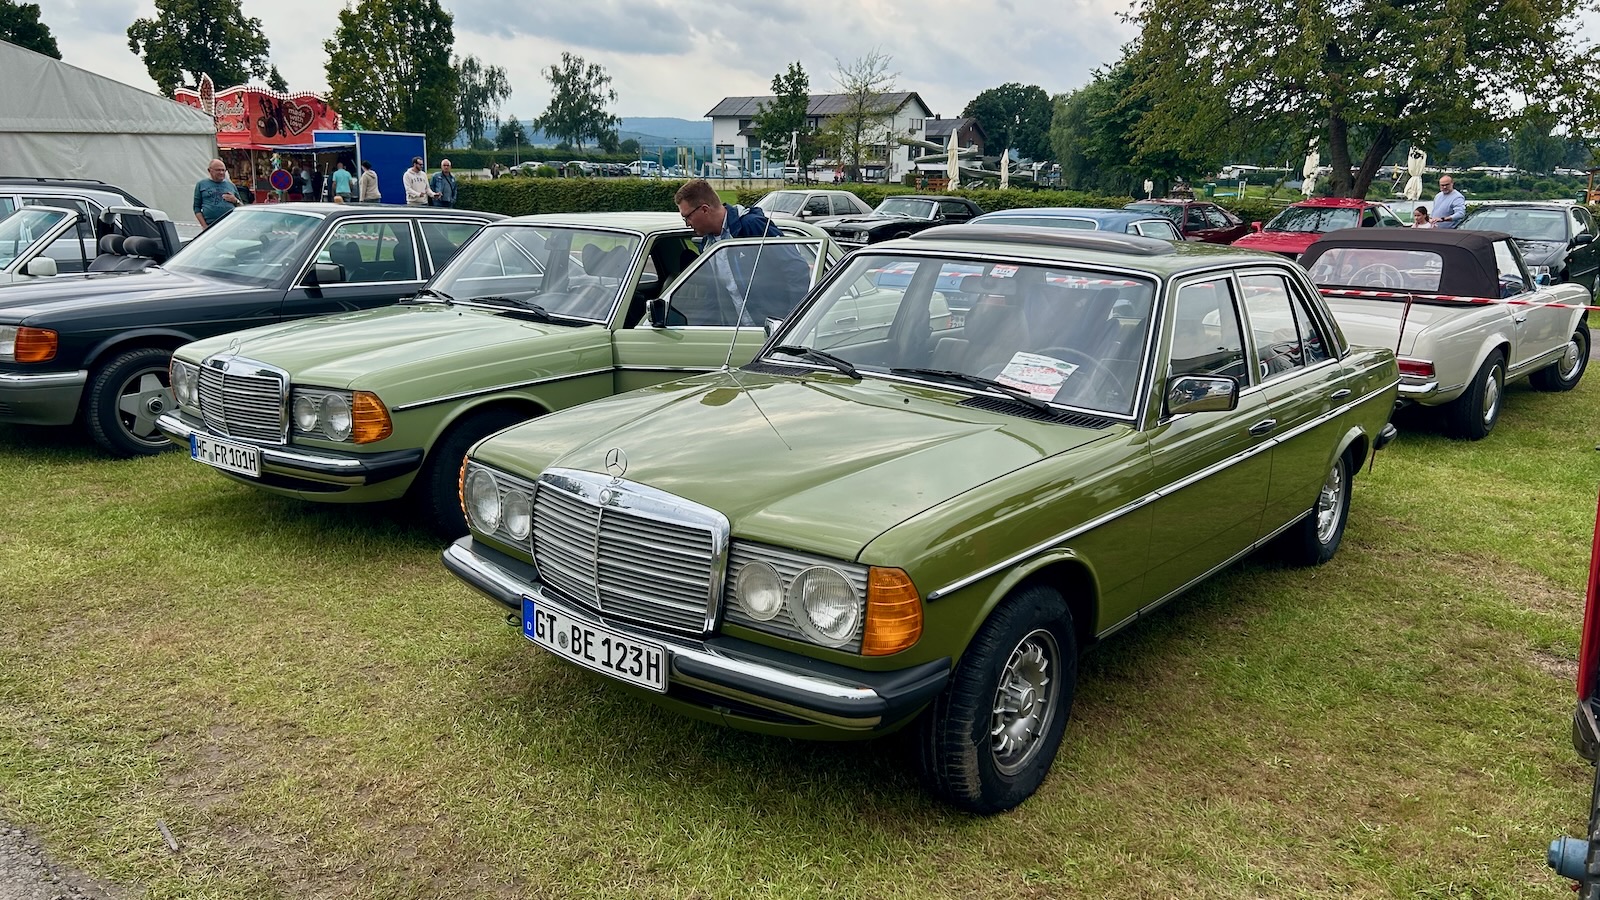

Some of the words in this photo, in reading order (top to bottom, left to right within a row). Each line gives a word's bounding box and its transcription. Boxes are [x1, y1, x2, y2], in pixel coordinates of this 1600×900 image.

[288, 108, 305, 117] made
[290, 115, 303, 123] with
[197, 439, 207, 458] HF
[214, 443, 228, 465] FR
[229, 447, 257, 472] 101H
[526, 621, 532, 631] D
[535, 609, 557, 644] GT
[571, 624, 596, 662] BE
[601, 637, 660, 684] 123H
